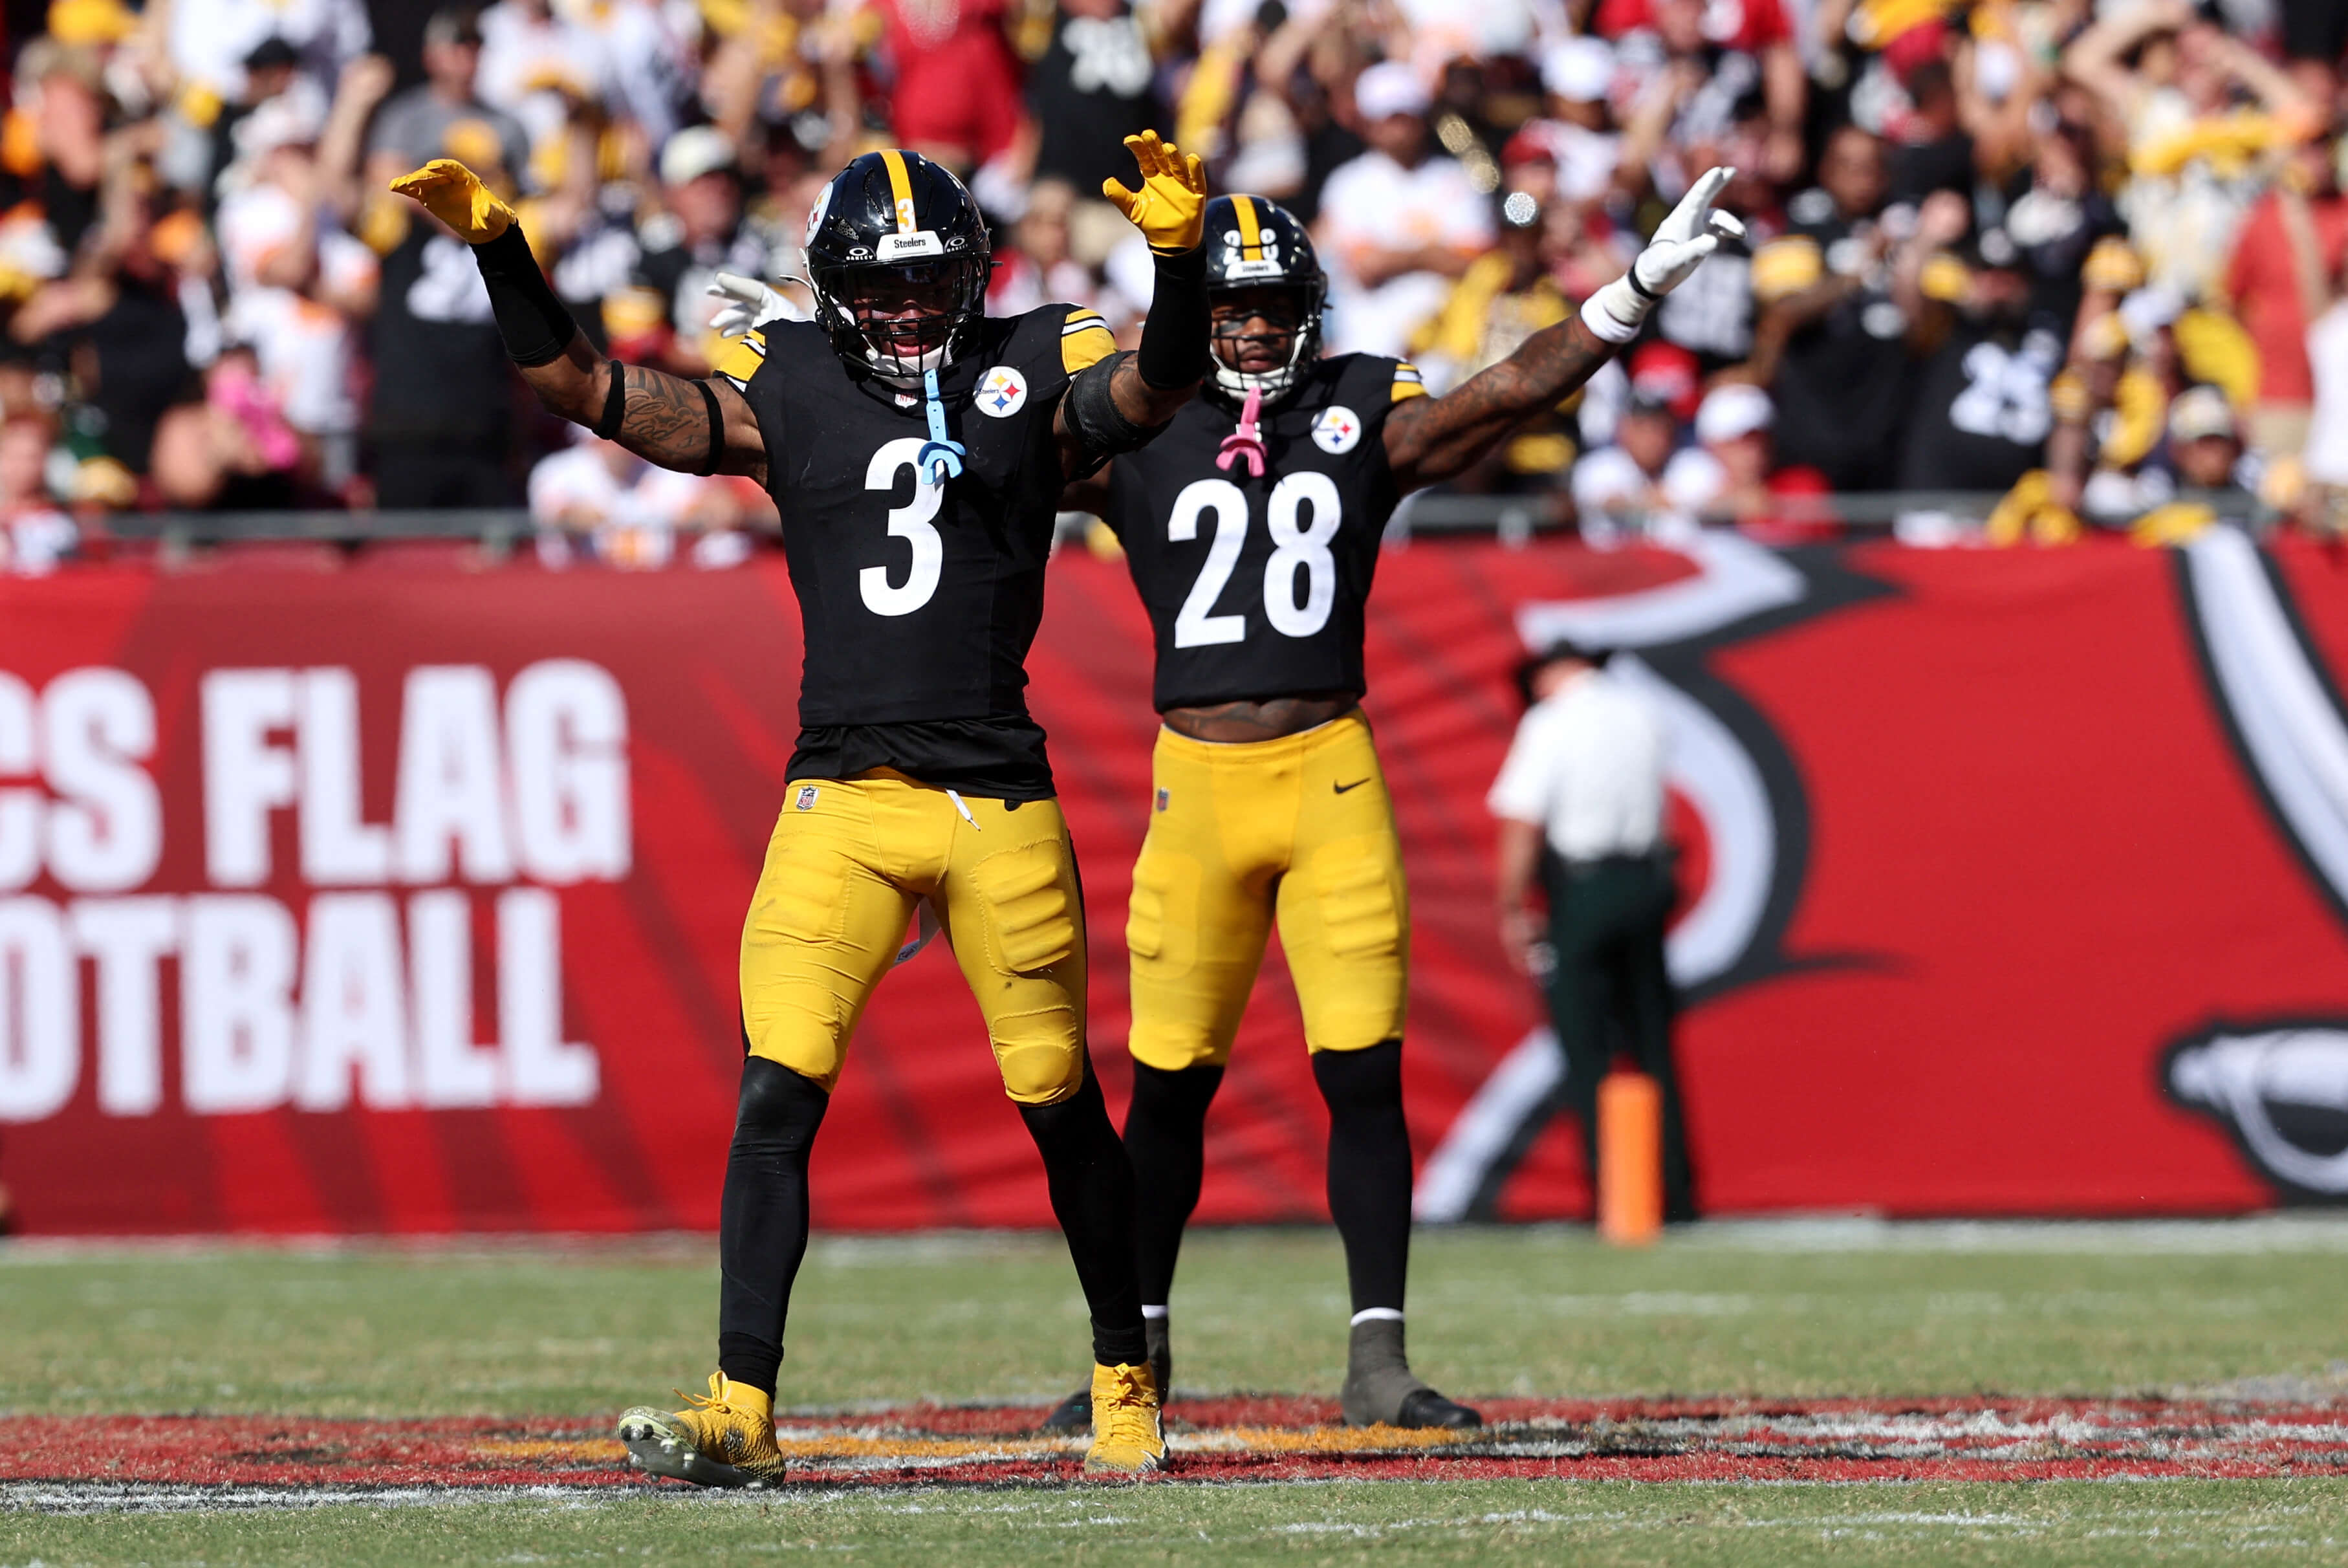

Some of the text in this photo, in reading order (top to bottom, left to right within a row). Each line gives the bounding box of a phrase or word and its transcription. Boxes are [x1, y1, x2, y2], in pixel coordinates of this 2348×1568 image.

[894, 237, 926, 249] Steelers
[897, 198, 916, 234] 3
[859, 437, 945, 616] 3
[1168, 471, 1342, 649] 28
[201, 659, 632, 887] FLAG
[0, 889, 600, 1122] OTBALL
